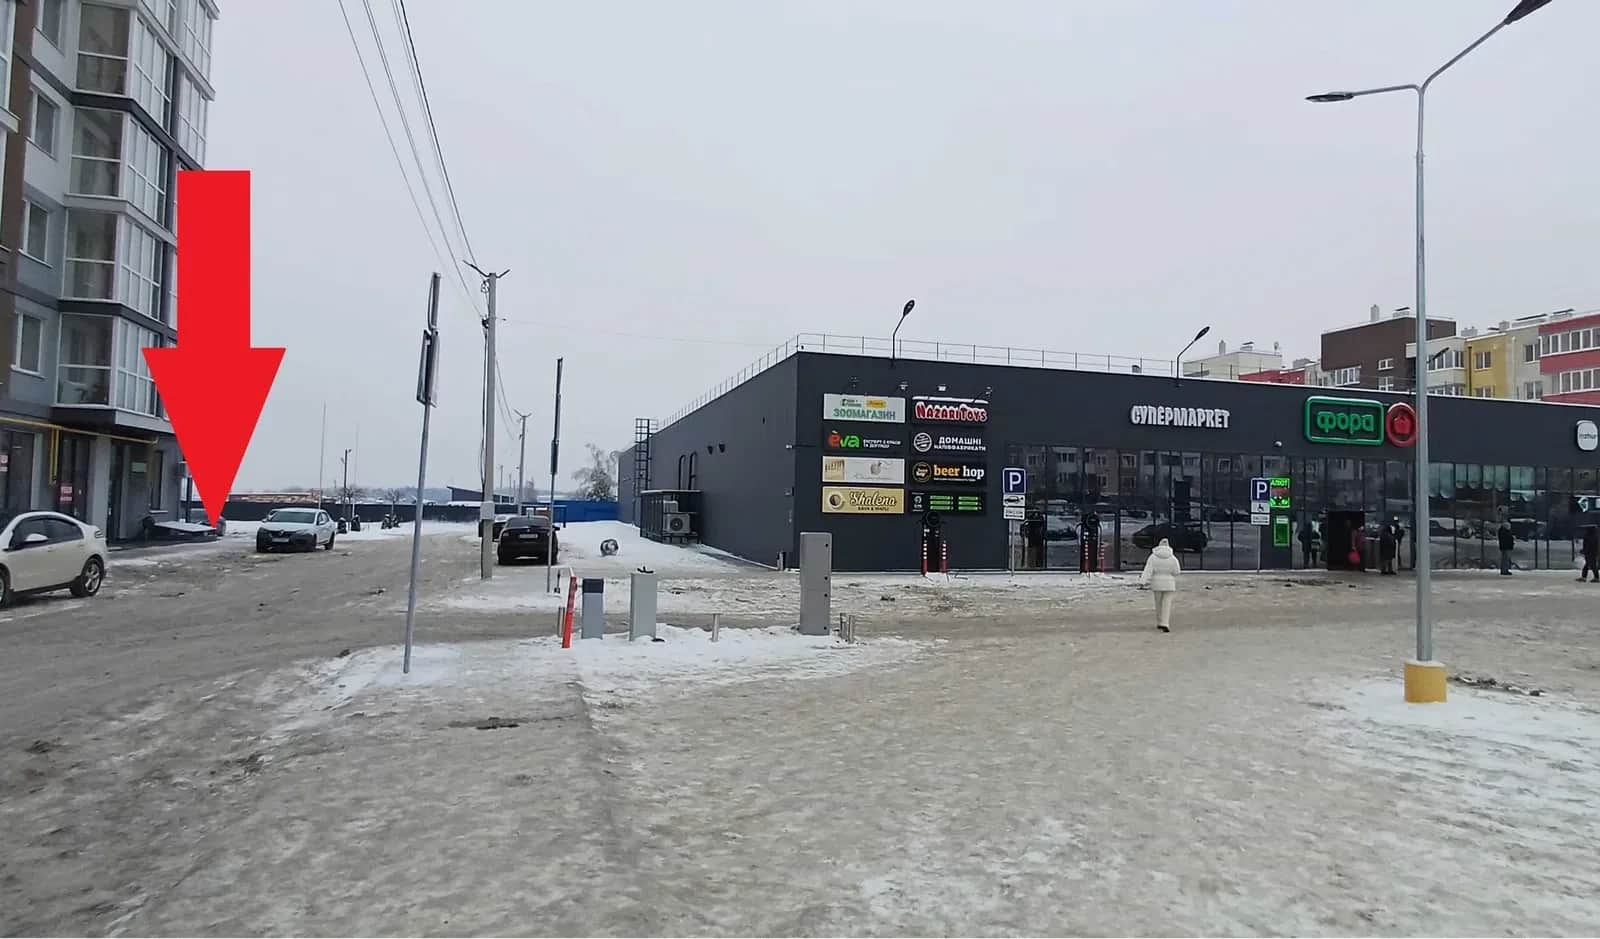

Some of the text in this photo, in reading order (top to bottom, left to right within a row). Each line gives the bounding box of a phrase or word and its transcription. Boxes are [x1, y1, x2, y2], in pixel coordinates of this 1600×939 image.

[833, 408, 896, 420] ЗООМАГАЗИН
[1131, 405, 1230, 428] СУПЕРМАРКЕТ
[934, 444, 986, 452] НАПІВФАБРИКАТИ
[938, 436, 982, 445] ДОМАШНІ
[934, 464, 960, 477] beer
[962, 465, 985, 480] hop
[1009, 471, 1021, 491] P
[1256, 481, 1267, 499] P
[849, 491, 897, 507] Shalena
